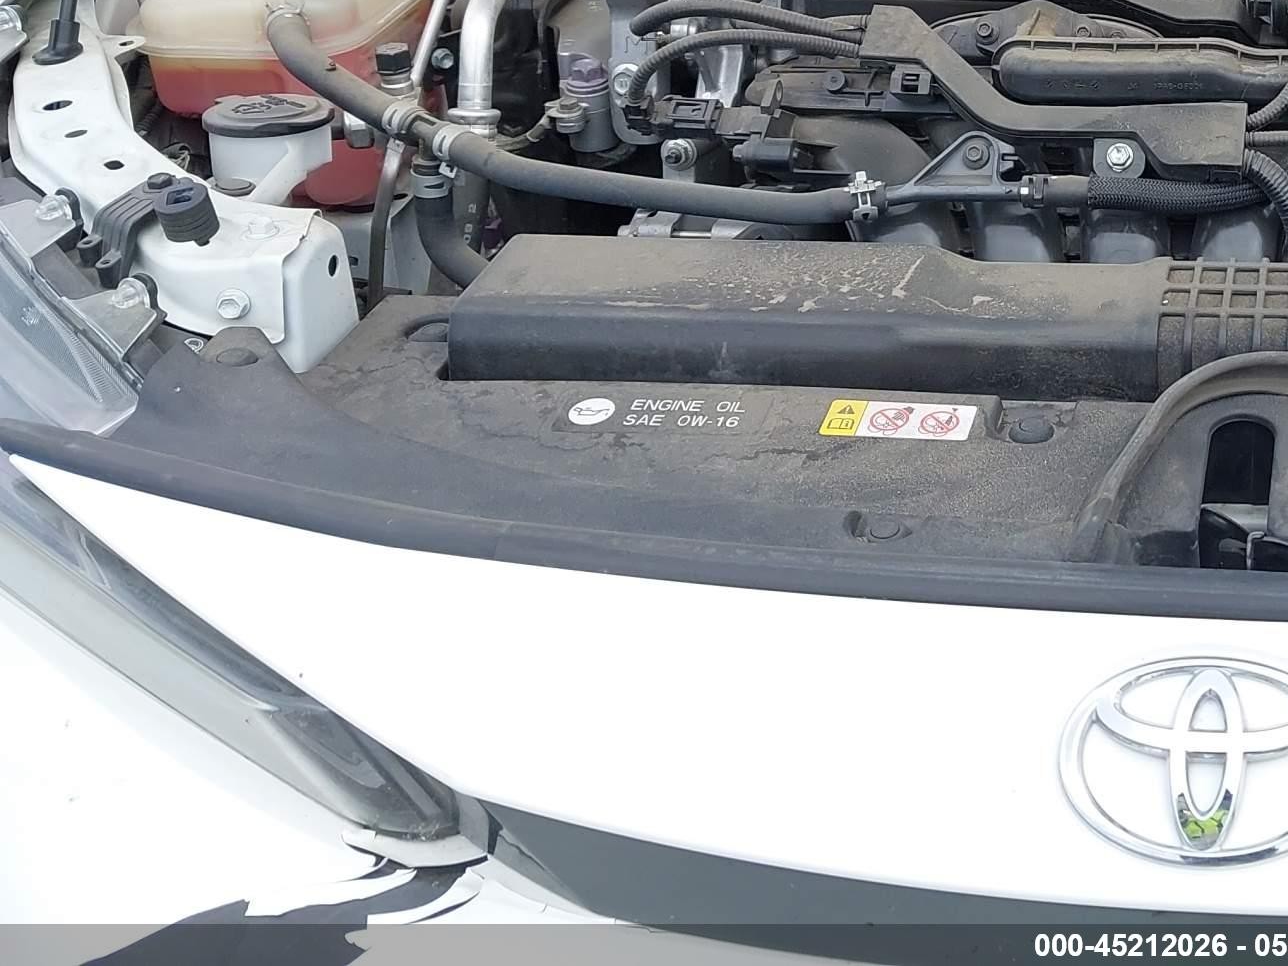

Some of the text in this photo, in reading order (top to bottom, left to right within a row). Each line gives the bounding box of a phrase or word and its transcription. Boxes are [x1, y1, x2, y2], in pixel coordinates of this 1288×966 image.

[630, 399, 746, 413] ENGINE OIL
[622, 414, 666, 426] SAE
